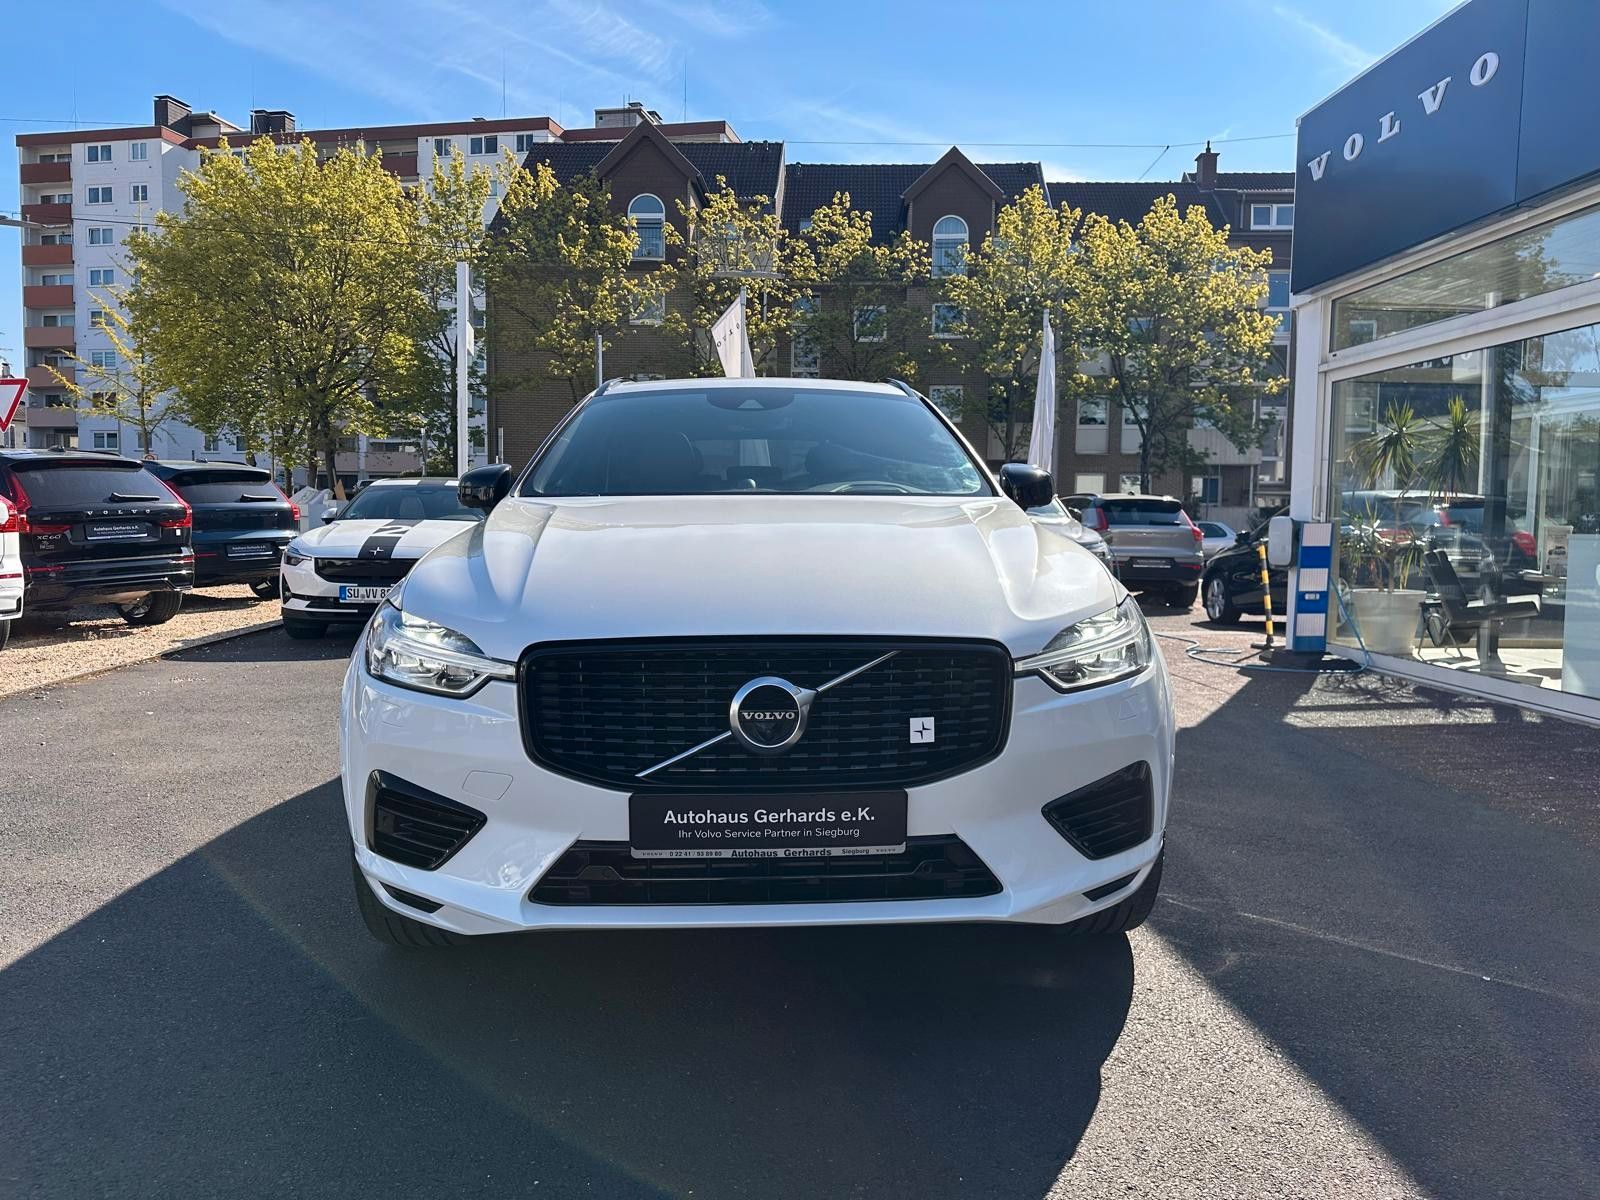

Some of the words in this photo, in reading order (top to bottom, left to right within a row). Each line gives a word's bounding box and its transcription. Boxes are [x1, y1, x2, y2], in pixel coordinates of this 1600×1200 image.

[1307, 52, 1499, 182] VOLVO
[347, 588, 360, 599] SU
[365, 588, 378, 599] VV
[742, 711, 796, 720] VOLVO
[663, 809, 749, 824] Autohaus
[753, 807, 836, 823] Gerhards
[840, 807, 875, 821] e.K.
[678, 829, 692, 838] Ihr
[694, 829, 722, 839] Volvo
[724, 828, 762, 838] Service
[764, 828, 801, 838] Partner
[803, 828, 813, 838] in
[815, 827, 860, 839] Siegburg
[731, 849, 778, 858] Autohaus
[783, 848, 832, 857] Gerhards
[841, 847, 870, 856] Siegburg
